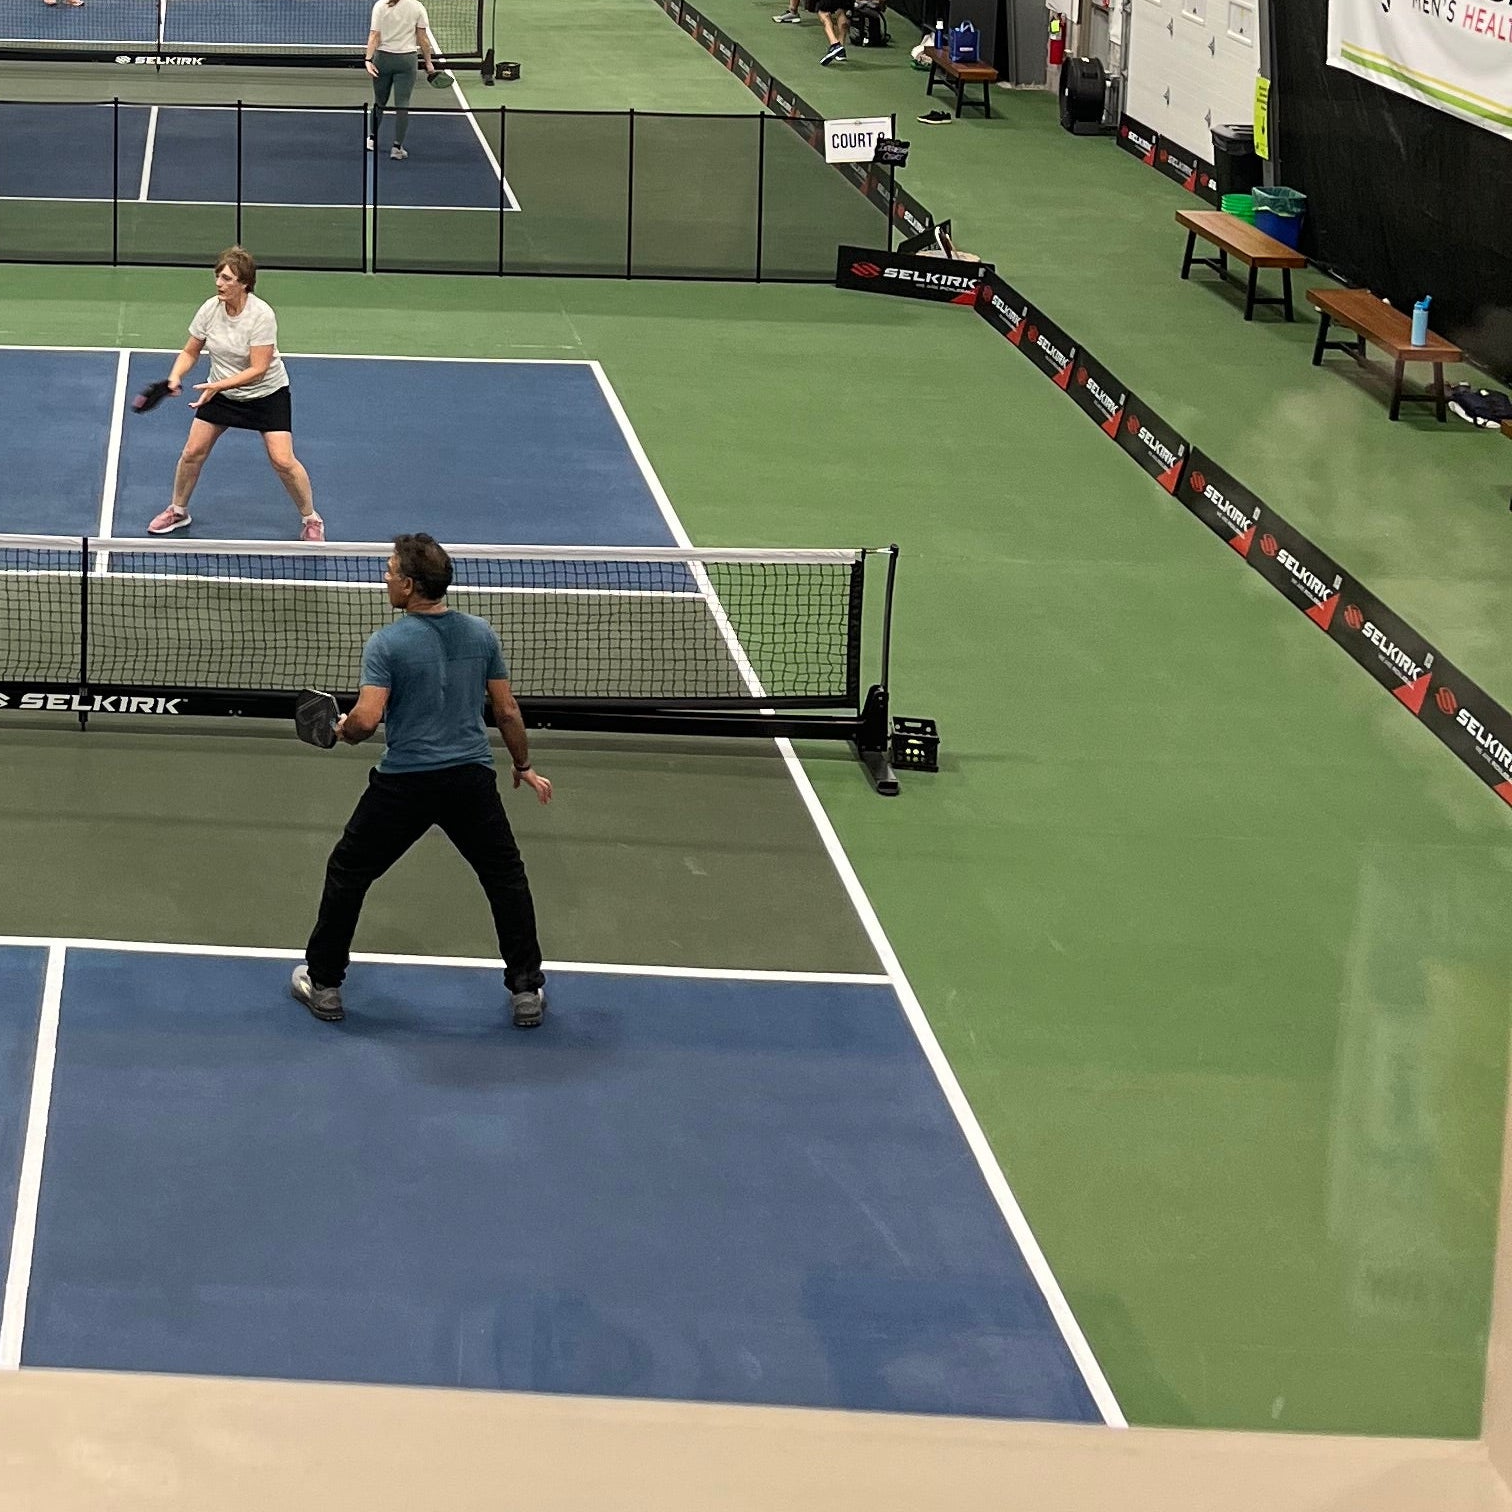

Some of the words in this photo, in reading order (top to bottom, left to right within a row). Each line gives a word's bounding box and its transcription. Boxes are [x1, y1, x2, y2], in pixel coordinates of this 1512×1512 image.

[135, 56, 206, 66] SELKIRK
[832, 132, 874, 149] COURT
[883, 267, 977, 289] SELKIRK
[991, 294, 1023, 326] SELKIRK
[1036, 334, 1070, 368] SELKIRK
[1086, 377, 1119, 415] SELKIRK
[1137, 426, 1177, 468] SELKIRK
[1203, 484, 1253, 531] SELKIRK
[1276, 548, 1334, 602] SELKIRK
[1361, 621, 1424, 682] SELKIRK
[19, 692, 182, 715] SELKIRK
[1456, 708, 1512, 773] SELKIR
